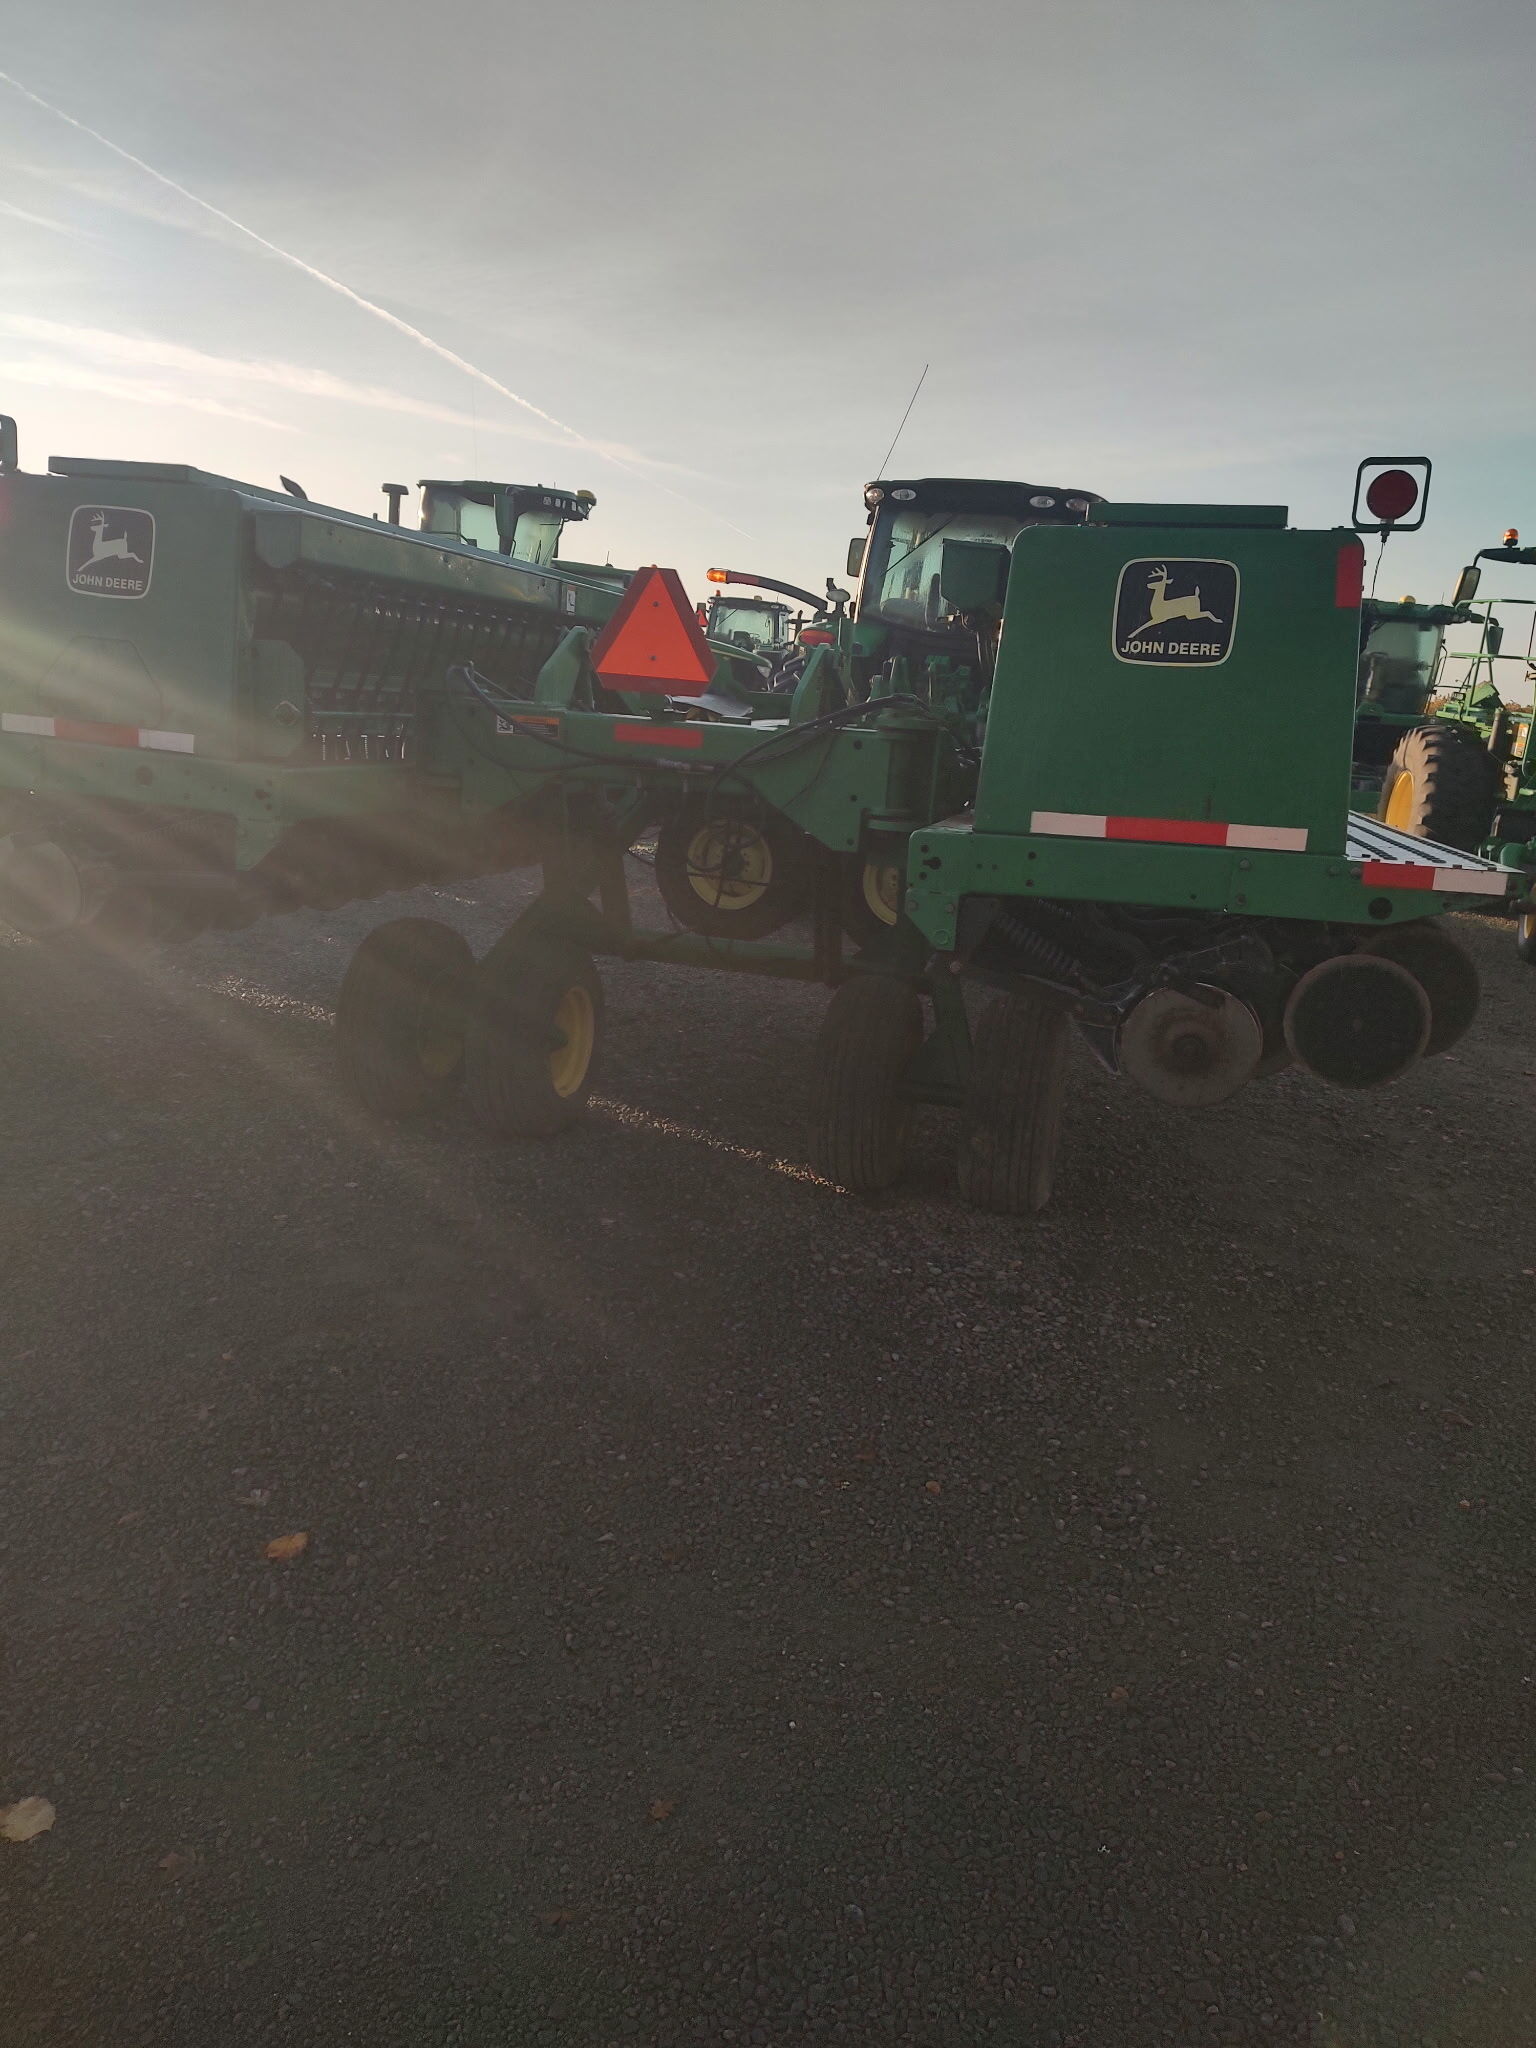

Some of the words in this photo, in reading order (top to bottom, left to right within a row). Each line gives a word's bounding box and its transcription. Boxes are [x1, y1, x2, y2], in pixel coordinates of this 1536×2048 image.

[72, 574, 103, 587] JOHN
[105, 577, 143, 591] DEERE
[1120, 640, 1165, 655] JOHN
[1167, 642, 1222, 656] DEERE
